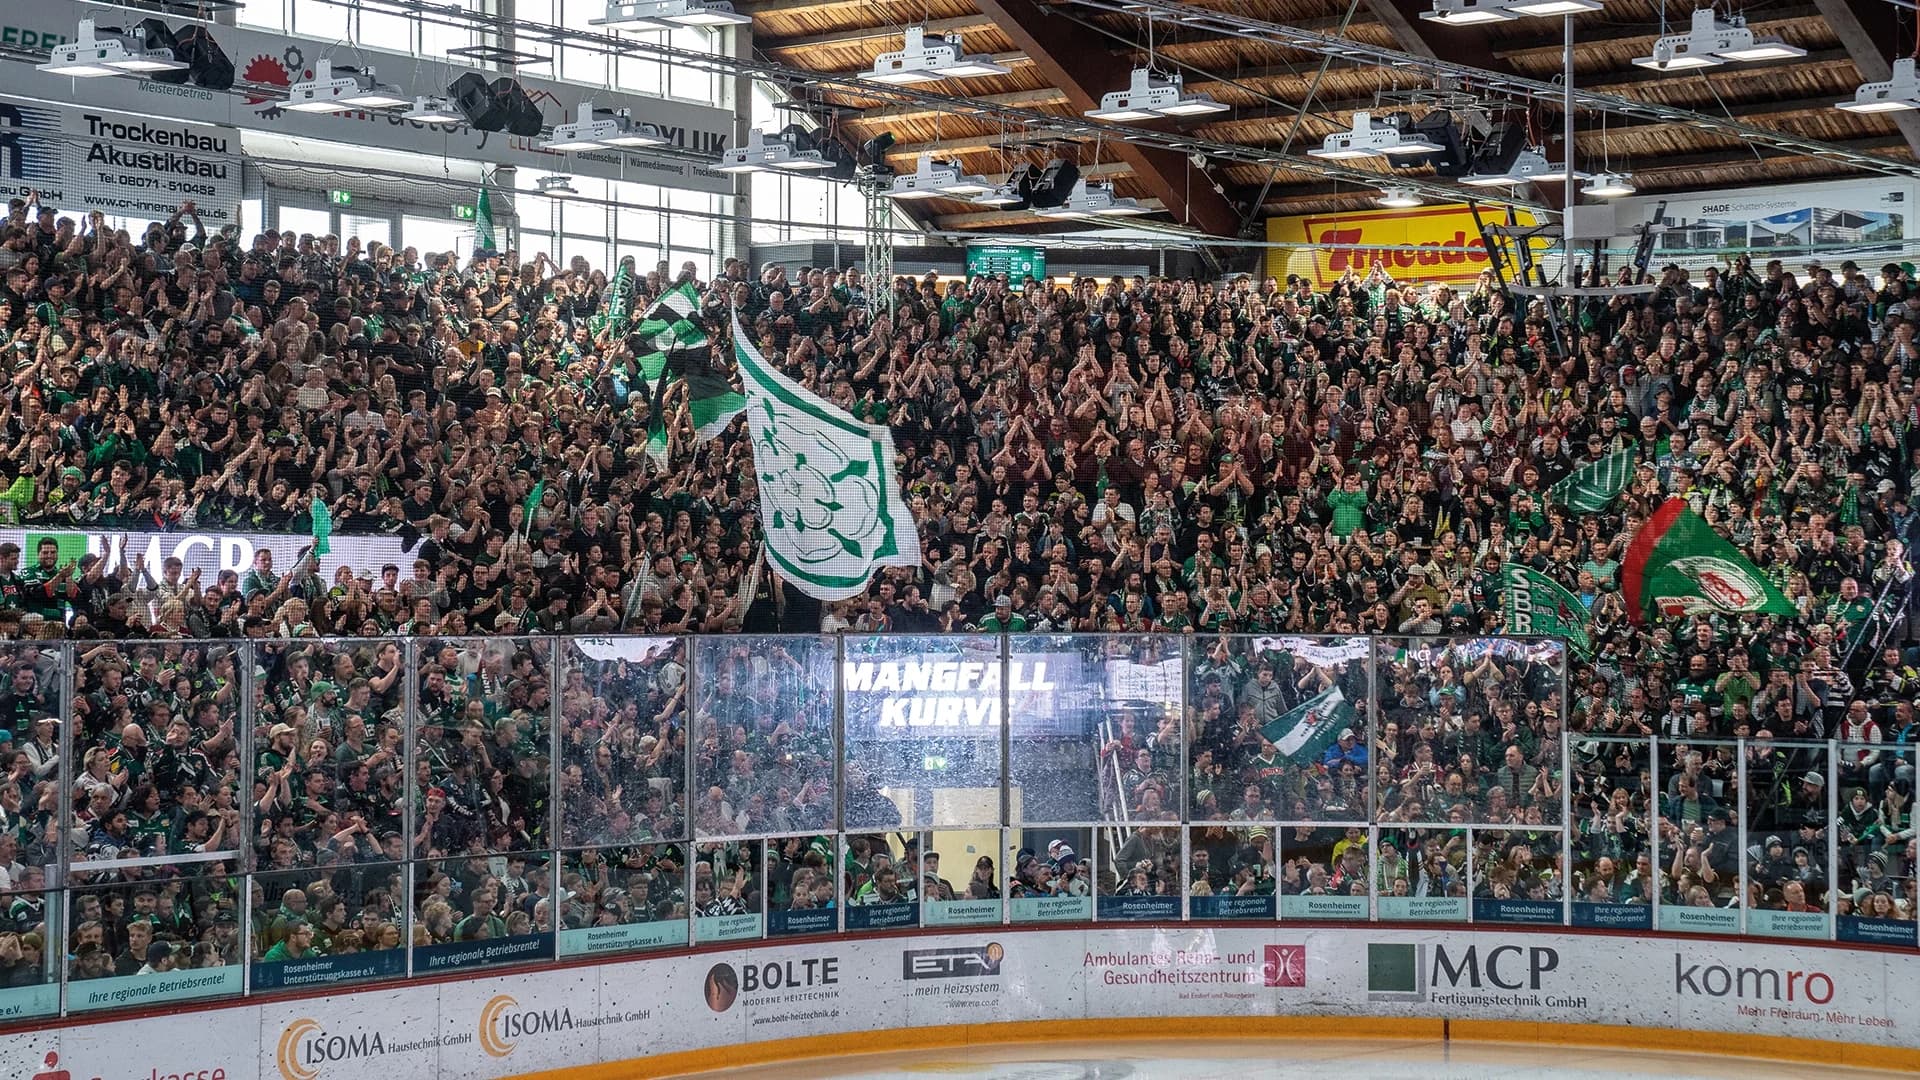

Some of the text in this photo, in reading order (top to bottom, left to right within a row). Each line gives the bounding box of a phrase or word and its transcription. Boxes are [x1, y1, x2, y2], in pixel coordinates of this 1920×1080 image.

[138, 79, 214, 101] Meisterbetrieb
[83, 114, 228, 153] Trockenbau
[86, 143, 228, 180] Akustikbau
[98, 172, 117, 185] Tel.
[119, 175, 159, 189] 08071
[169, 181, 216, 196] 510452
[1702, 204, 1730, 214] SHADE
[844, 661, 1055, 691] MANGFALL
[1053, 898, 1082, 909] regionale
[1122, 901, 1174, 910] Rosenheimer
[1234, 897, 1266, 907] regionale
[1308, 901, 1361, 910] Rosenheimer
[1425, 899, 1458, 909] regionale
[869, 905, 911, 916] Ihre regionale
[948, 906, 996, 914] Rosenheimer
[1037, 907, 1083, 917] Betriebsrente!
[1219, 906, 1267, 915] Betriebsrente!
[1409, 907, 1459, 916] Betriebsrente!
[1500, 904, 1556, 914] Rosenheimer
[1610, 907, 1645, 916] regionale
[787, 914, 831, 924] Rosenheimer
[869, 914, 912, 926] Betriebsrente!
[1594, 914, 1646, 922] Betriebsrente!
[1680, 911, 1735, 922] Rosenheimer
[1771, 914, 1822, 924] Ihre regionale
[1771, 923, 1823, 932] Betriebsrente!
[1858, 921, 1914, 934] Rosenheimer
[587, 930, 628, 940] Rosenheimer
[429, 939, 540, 968] Ihre regionale Betriebsrente!
[1083, 952, 1171, 967] Ambulantes
[1227, 950, 1255, 964] und
[283, 961, 333, 974] Rosenheimer
[912, 954, 990, 973] ETA
[1431, 944, 1560, 990] MCP
[283, 967, 377, 985] Unterstützungskasse e.V.
[742, 957, 838, 992] BOLTE
[1103, 969, 1257, 985] Gesundheitszentrum
[1675, 952, 1835, 1005] komro
[88, 973, 225, 1004] Ihre regionale Betriebsrente!
[943, 982, 1000, 998] Heizsystem
[742, 990, 840, 1007] MODERNE HEIZTECHNIK
[1432, 992, 1588, 1009] Fertigungstechnik GmbH
[6, 1005, 22, 1015] e.V.
[753, 1008, 840, 1025] www.bolte-heiztechnik.de
[1737, 1004, 1766, 1018] Mehr
[1826, 1012, 1856, 1026] Mehr
[1858, 1014, 1897, 1029] Leben.
[504, 1007, 651, 1038] ISOMA Haustechnik GmbH
[306, 1031, 472, 1064] ISOMA Haustechnik GmbH
